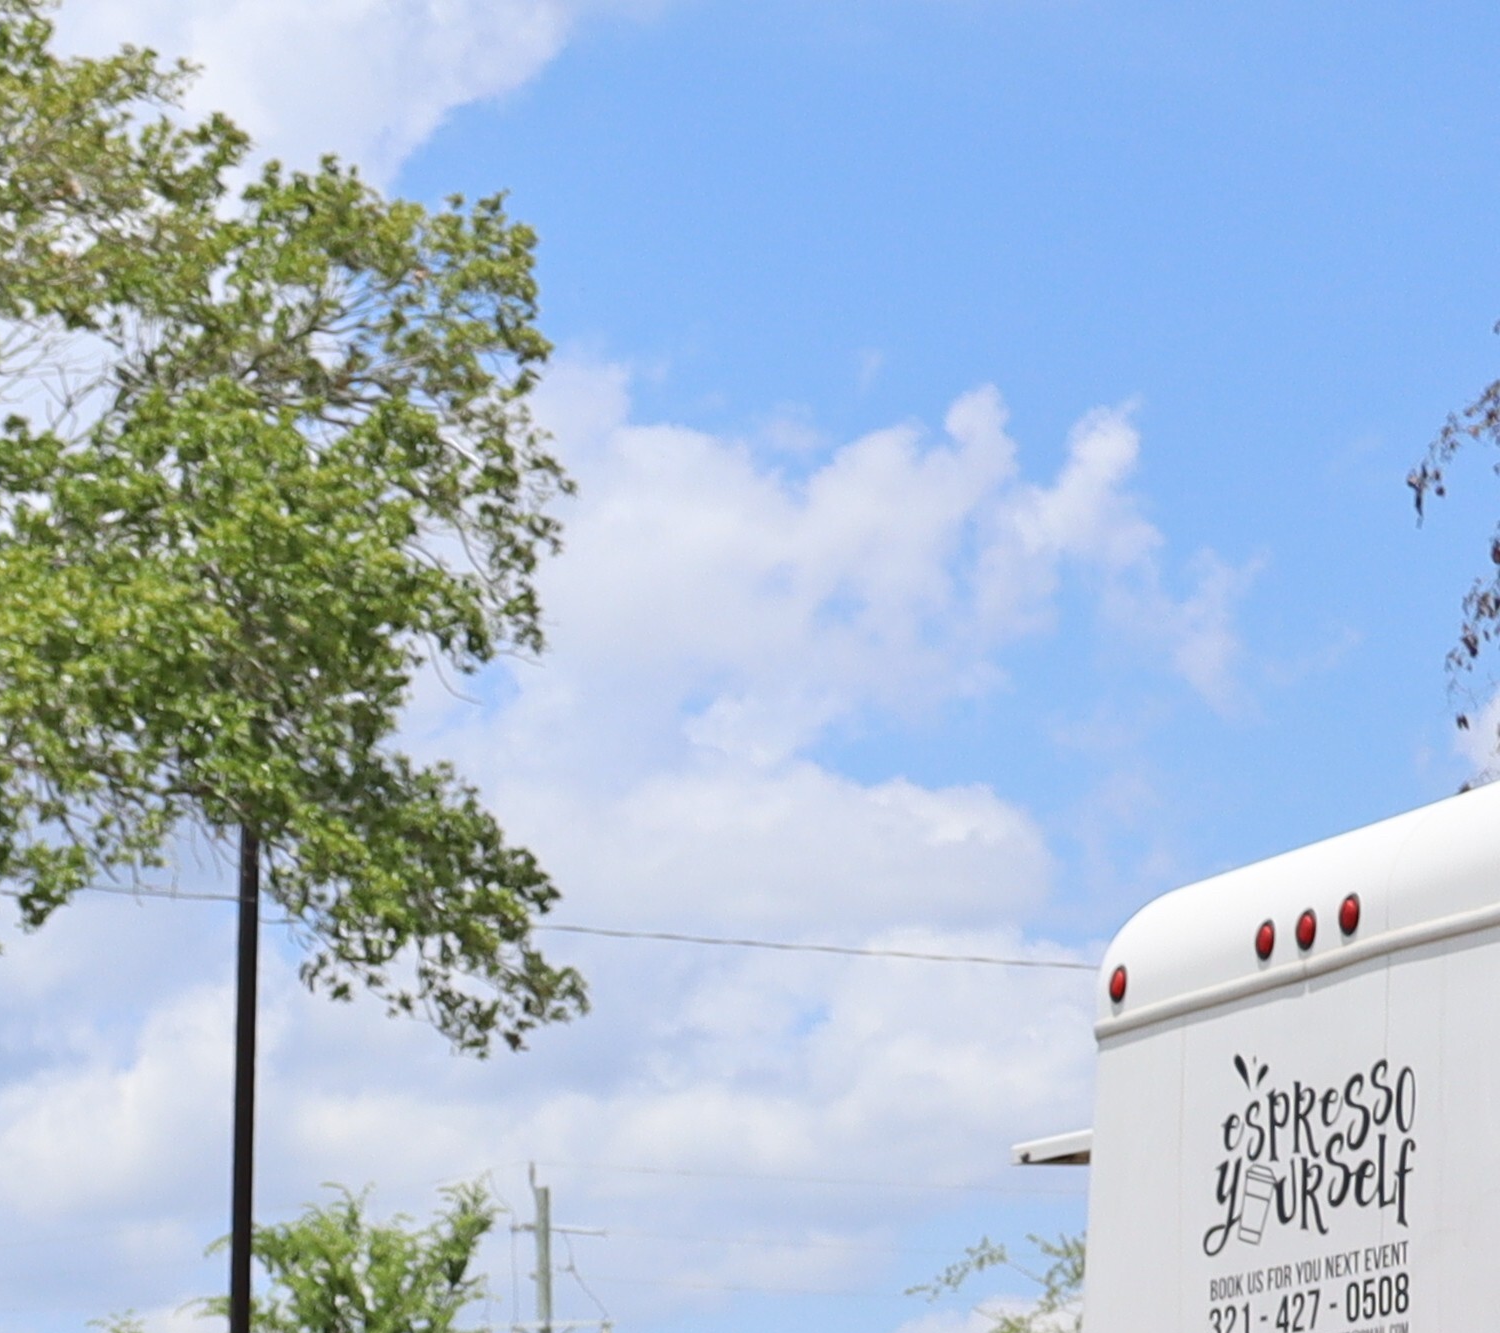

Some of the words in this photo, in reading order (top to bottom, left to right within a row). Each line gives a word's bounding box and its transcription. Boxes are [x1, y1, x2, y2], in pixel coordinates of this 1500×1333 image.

[1210, 1272, 1243, 1301] BOOK
[1247, 1270, 1264, 1294] US
[1267, 1265, 1292, 1291] FOR
[1296, 1260, 1322, 1285] YOU
[1325, 1251, 1361, 1279] NEXT
[1364, 1241, 1410, 1271] EVENT
[1276, 1289, 1321, 1333] 427
[1346, 1272, 1410, 1322] 0508
